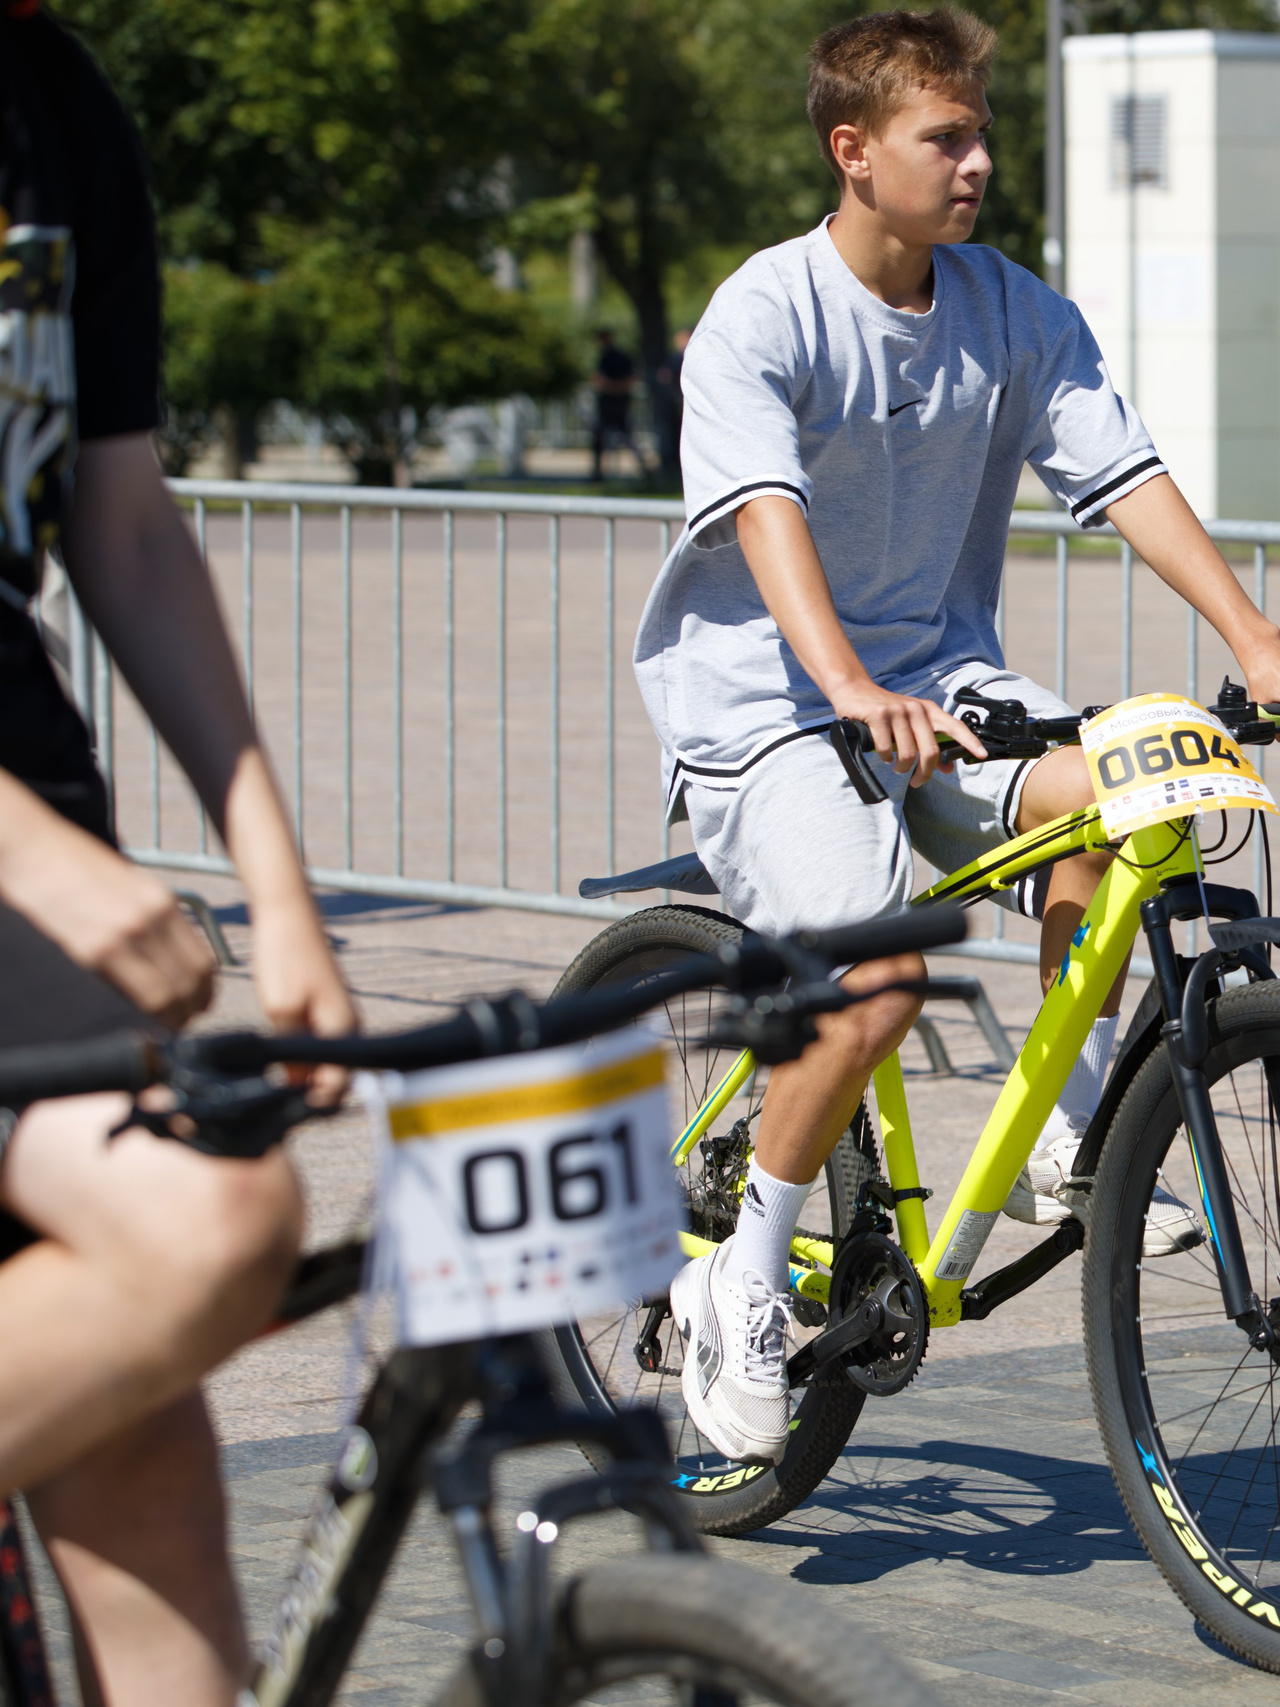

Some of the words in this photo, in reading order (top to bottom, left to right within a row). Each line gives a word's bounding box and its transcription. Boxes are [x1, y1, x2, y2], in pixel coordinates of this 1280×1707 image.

[1110, 707, 1181, 732] Массовый
[1097, 730, 1241, 789] 0604
[462, 1117, 640, 1235] 061
